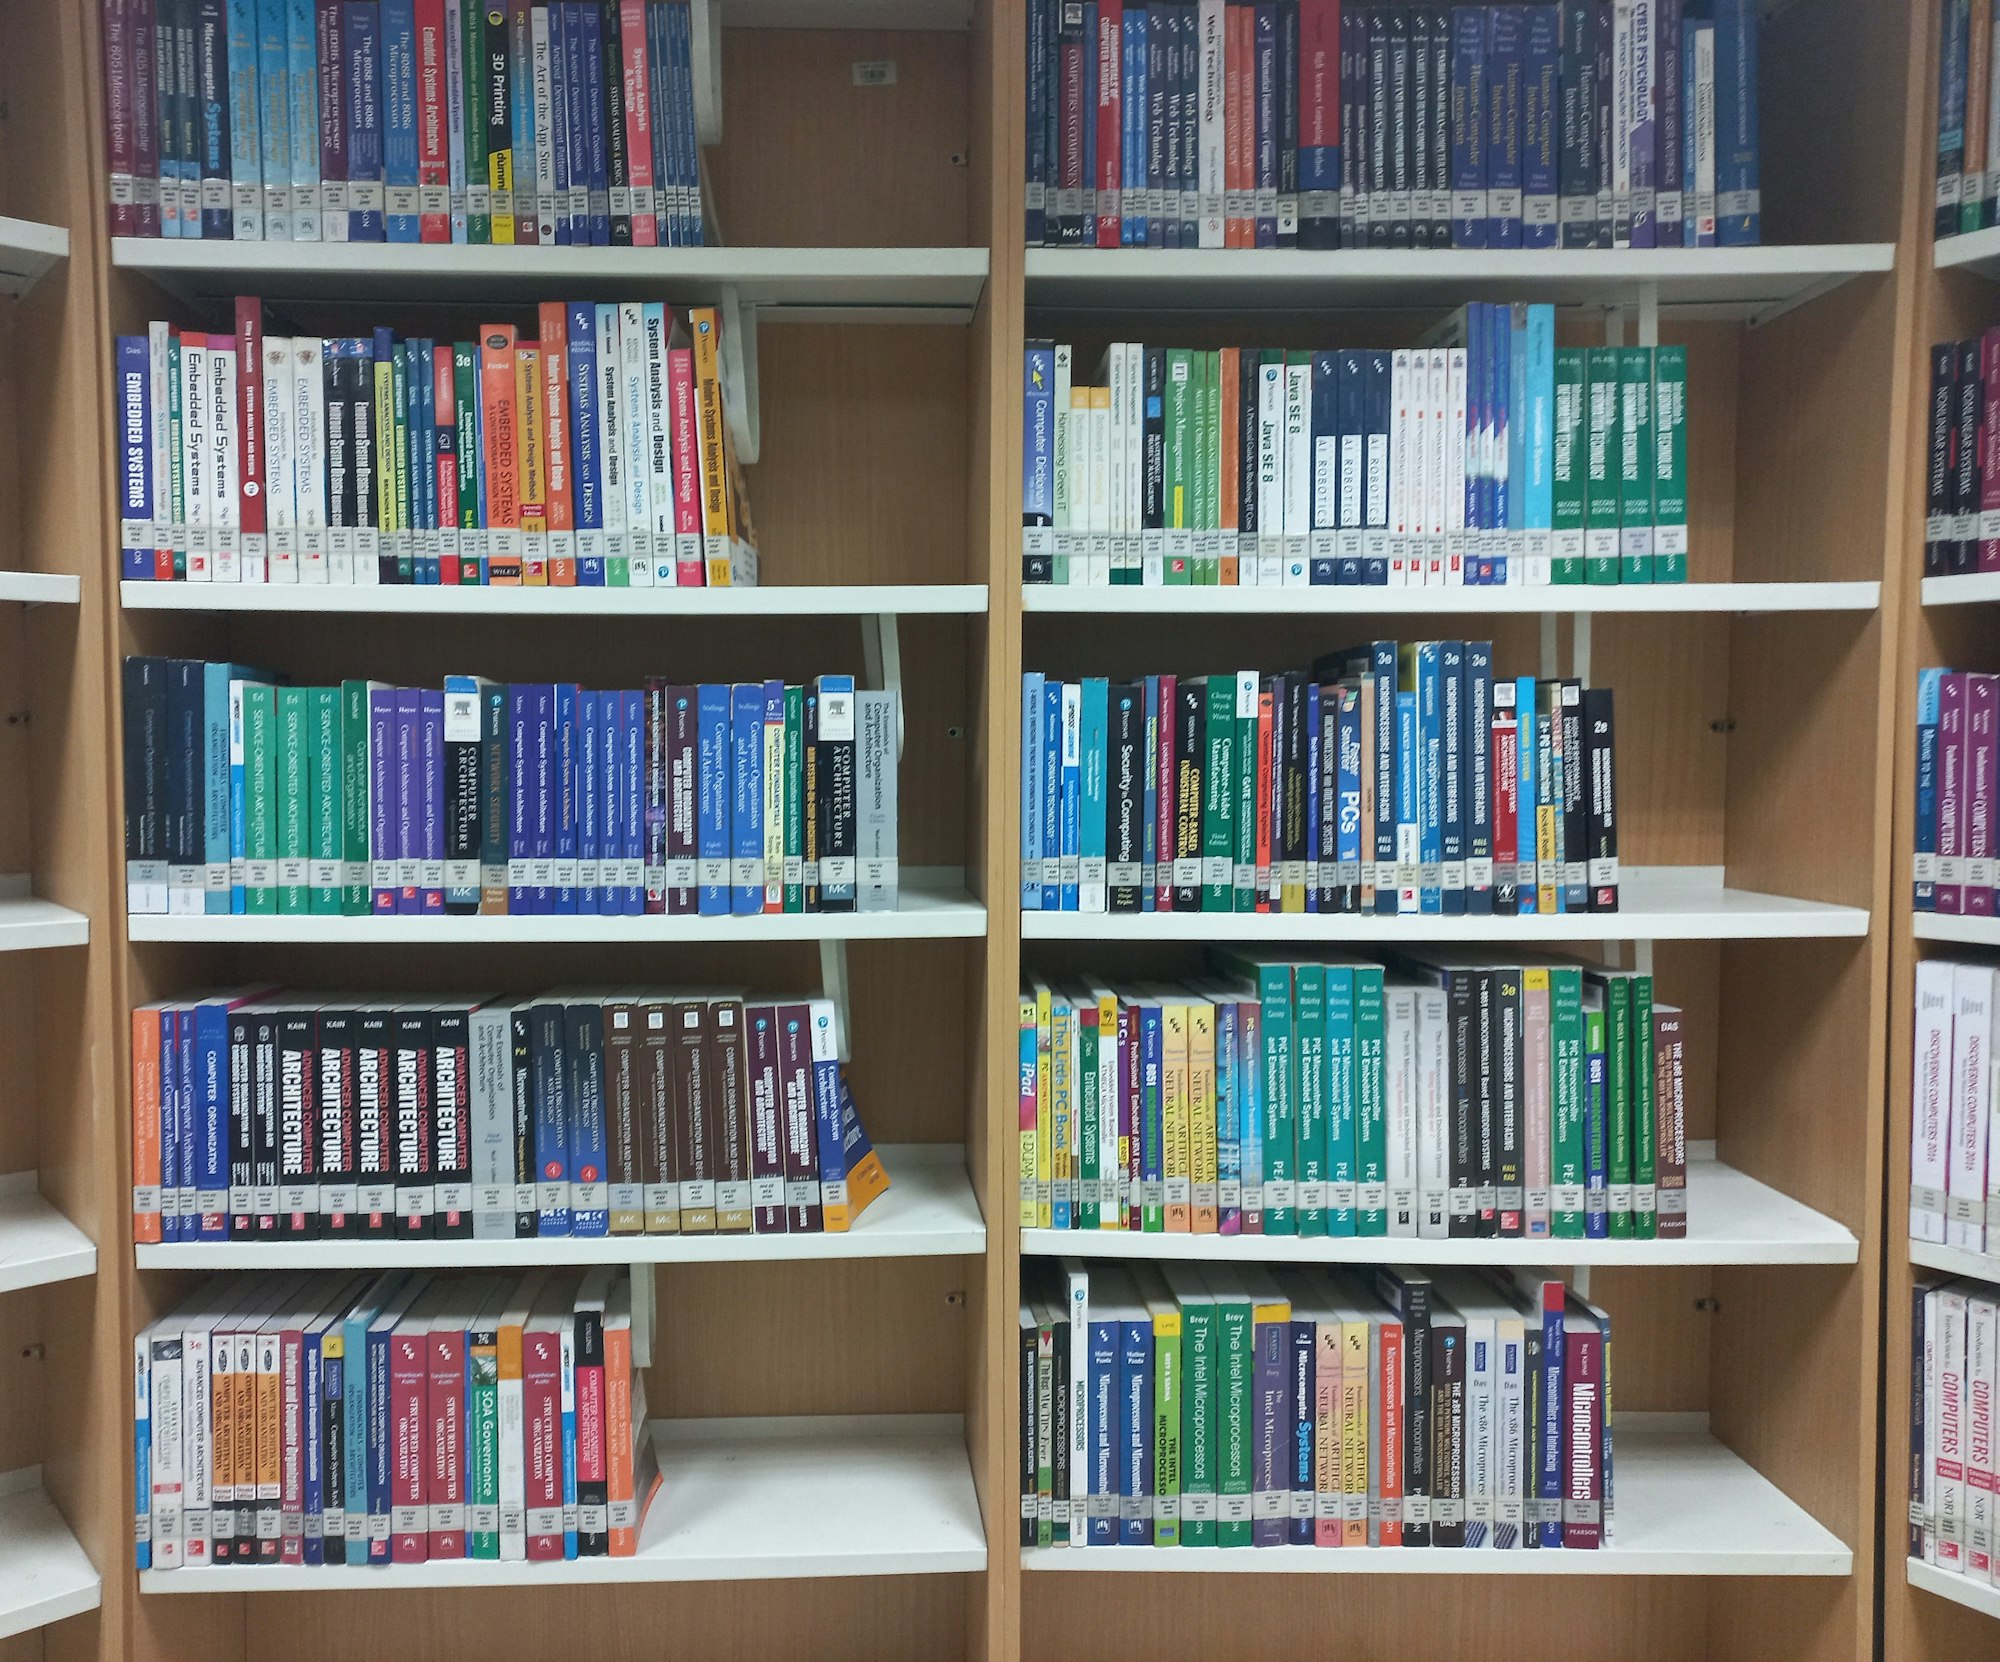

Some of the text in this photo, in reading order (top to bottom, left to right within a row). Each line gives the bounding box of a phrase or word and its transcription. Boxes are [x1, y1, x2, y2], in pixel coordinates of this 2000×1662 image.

[204, 22, 221, 169] Microcomputer Systems
[352, 50, 363, 129] Microprocessors
[363, 36, 372, 54] The
[364, 84, 372, 102] and
[423, 26, 439, 156] Embedded Systems Architecture
[492, 54, 505, 126] 3D Printing
[1205, 14, 1216, 122] Web Technology
[1636, 3, 1648, 121] CYBER PSYCHOLOGY
[537, 41, 549, 180] The Art of the App Store
[552, 45, 566, 184] Android Development Patterns
[1168, 94, 1180, 178] Web Technology
[1183, 92, 1196, 176] Web Technology
[1455, 86, 1466, 144] Interaction
[1468, 64, 1482, 166] Human-Computer
[1565, 88, 1576, 148] Interaction
[1580, 64, 1592, 168] Human-Computer
[126, 372, 144, 508] EMBEDDED SYSTEMS
[187, 353, 202, 496] Embedded Systems
[213, 356, 228, 498] Embedded Systems
[298, 378, 312, 493] EMBEDDED SYSTEMS
[578, 363, 594, 524] SYSTEMS ANALYSIS AND DESIGN
[646, 318, 664, 474] System Analysis and Design
[678, 381, 692, 502] Systems Analysis and Design
[1174, 365, 1187, 482] IT Project Management
[1657, 382, 1672, 480] INFORMATION TECHNOLOGY
[1960, 384, 1974, 496] NONLINEAR SYSTEMS
[354, 402, 371, 494] EMBEDDED SYSTEM DESIGN
[498, 400, 514, 524] EMBEDDED SYSTEMS
[1034, 400, 1048, 508] Computer Dictionary
[1056, 412, 1067, 511] Harnessing Green IT
[1262, 420, 1274, 482] Java SE 8
[1318, 440, 1328, 524] AI ROBOTICS
[492, 567, 519, 576] WILEY
[320, 709, 330, 858] SERVICE-ORIENTED ARCHITECTURE
[468, 747, 477, 821] COMPUTER
[628, 727, 638, 837] Computer System Architecture
[702, 740, 713, 815] and Architecture
[712, 723, 725, 830] Computer Organization
[864, 702, 873, 779] and Architecture
[872, 702, 882, 810] Computer Organization
[1118, 744, 1132, 792] Security
[1178, 760, 1190, 814] INDUSTRIAL
[1208, 738, 1220, 811] Manufacturing
[1427, 738, 1439, 828] Microprocessors
[458, 747, 468, 850] ARCHITECTURE
[490, 743, 500, 844] NETWORK SECURITY
[1118, 799, 1132, 861] Computing
[1189, 769, 1200, 851] COMPUTER-BASED
[1340, 791, 1360, 833] PCs
[1940, 799, 1956, 856] COMPUTERS
[206, 1050, 217, 1174] COMPUTER ORGANIZATION
[282, 1050, 302, 1174] ARCHITECTURE
[302, 1048, 312, 1174] ADVANCED COMPUTER
[360, 1048, 380, 1173] ARCHITECTURE
[380, 1048, 390, 1171] ADVANCED COMPUTER
[436, 1046, 456, 1172] ARCHITECTURE
[763, 1067, 774, 1108] COMPUTER
[1020, 1063, 1035, 1096] iPad
[1055, 1020, 1068, 1149] The Little PC Book
[1083, 1072, 1096, 1164] Embedded Systems
[1266, 1036, 1277, 1140] and Embedded Systems
[1278, 1037, 1288, 1119] PIC Microcontroller
[1965, 1036, 1980, 1171] DISCOVERING COMPUTERS 2016
[482, 1391, 493, 1496] SOA Governance
[544, 1396, 554, 1500] STRUCTURED COMPUTER
[589, 1370, 598, 1479] COMPUTER ORGANIZATION
[1076, 1380, 1085, 1452] MICROPROCESSORS
[1228, 1326, 1242, 1476] The Intel Microprocessors
[1298, 1422, 1311, 1482] Systems
[1571, 1382, 1595, 1499] Microcontrollers
[1942, 1372, 1958, 1454] COMPUTERS
[1972, 1380, 1990, 1464] COMPUTERS
[1168, 1437, 1176, 1484] THE INTEL
